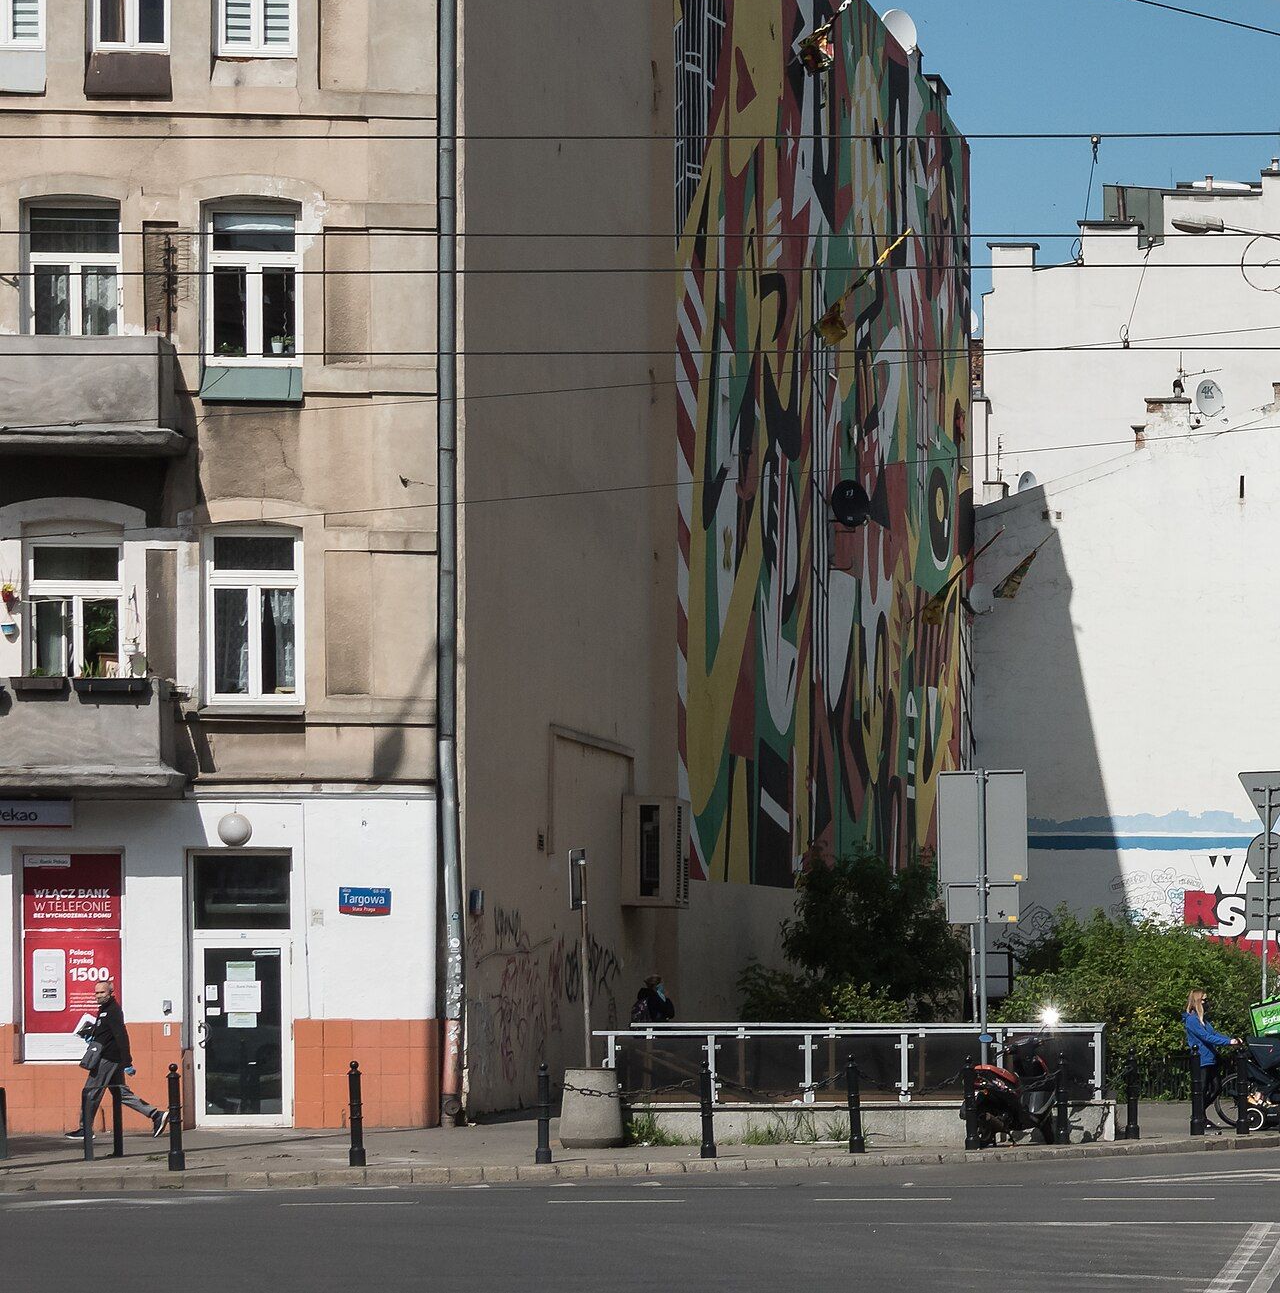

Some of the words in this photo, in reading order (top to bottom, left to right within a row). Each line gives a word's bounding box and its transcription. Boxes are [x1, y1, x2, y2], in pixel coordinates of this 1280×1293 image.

[33, 888, 76, 900] WŁĄCZ
[78, 888, 111, 899] BANK
[343, 893, 385, 906] Targowa
[33, 901, 46, 911] W
[48, 901, 111, 912] TELEFONIE
[69, 948, 94, 957] Polecaj
